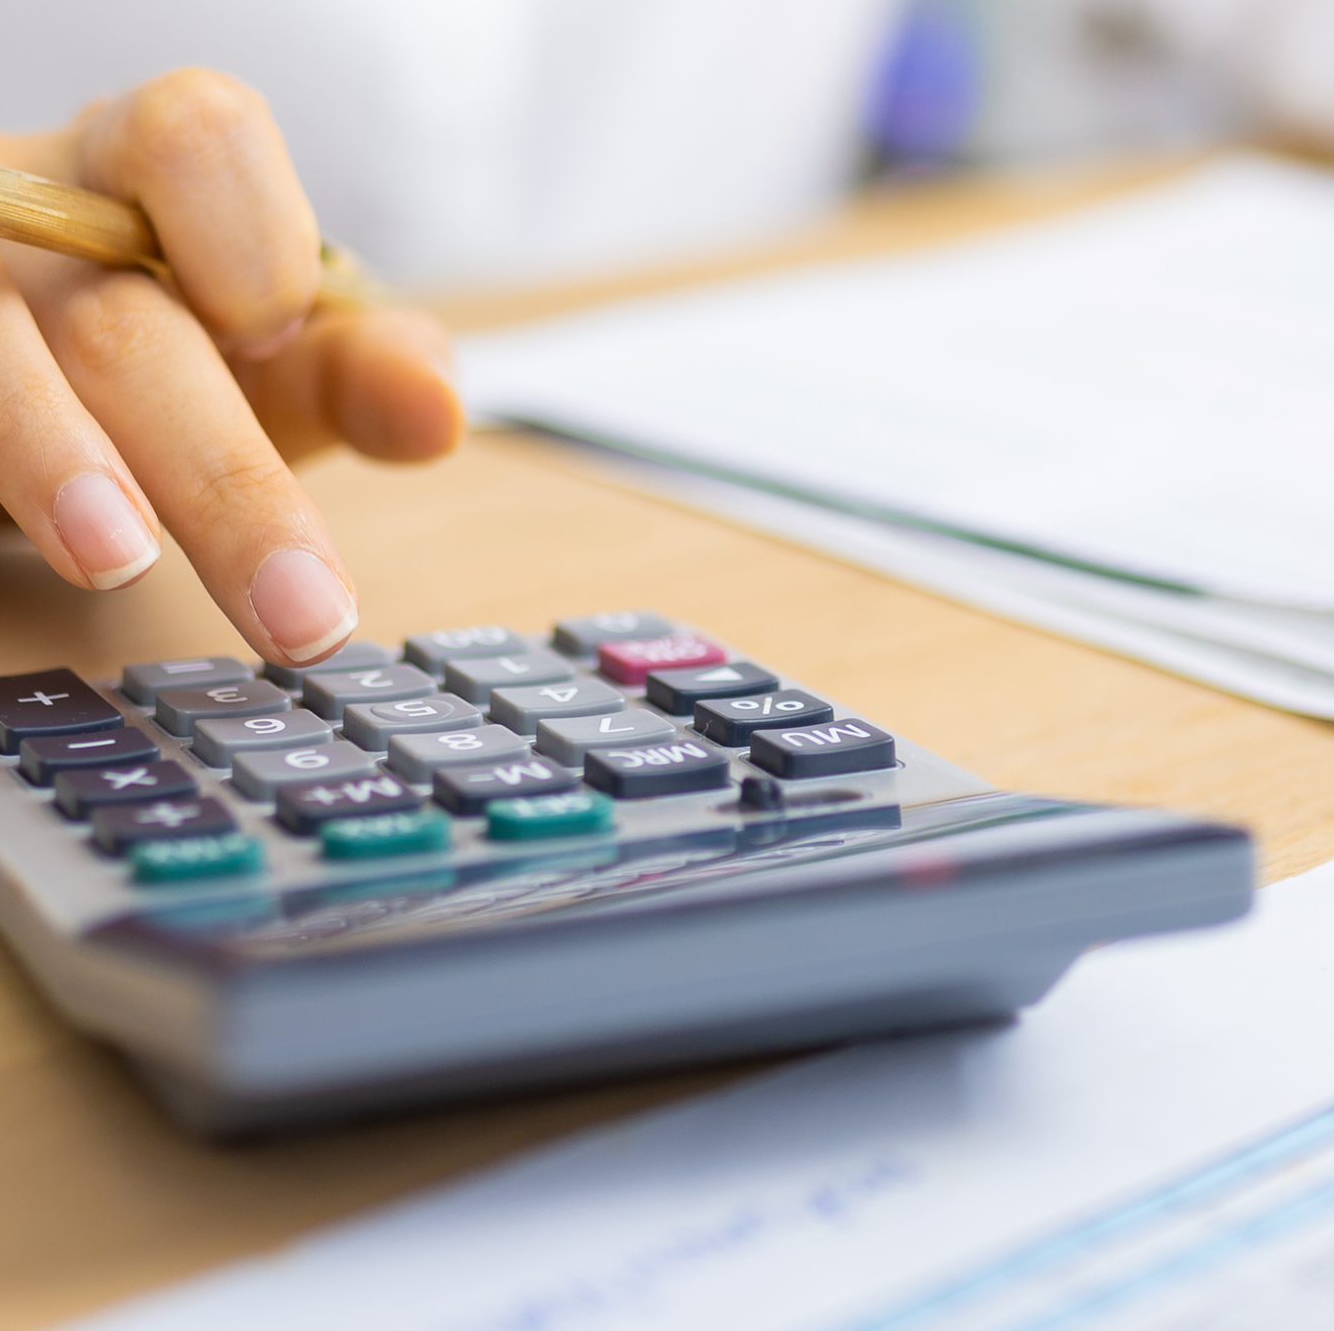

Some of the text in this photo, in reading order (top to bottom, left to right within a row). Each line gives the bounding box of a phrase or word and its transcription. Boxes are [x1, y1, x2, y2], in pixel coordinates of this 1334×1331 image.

[497, 658, 530, 675] 1
[347, 670, 395, 690] 2
[206, 685, 248, 703] 3
[539, 686, 578, 704] 4
[393, 700, 438, 718] 5
[730, 695, 805, 715] %
[244, 717, 287, 735] 6
[598, 717, 635, 735] 7
[780, 723, 872, 748] MU
[437, 732, 484, 751] 8
[284, 749, 330, 770] 9
[609, 742, 709, 769] MRC
[468, 761, 554, 787] M-
[302, 776, 403, 806] M+
